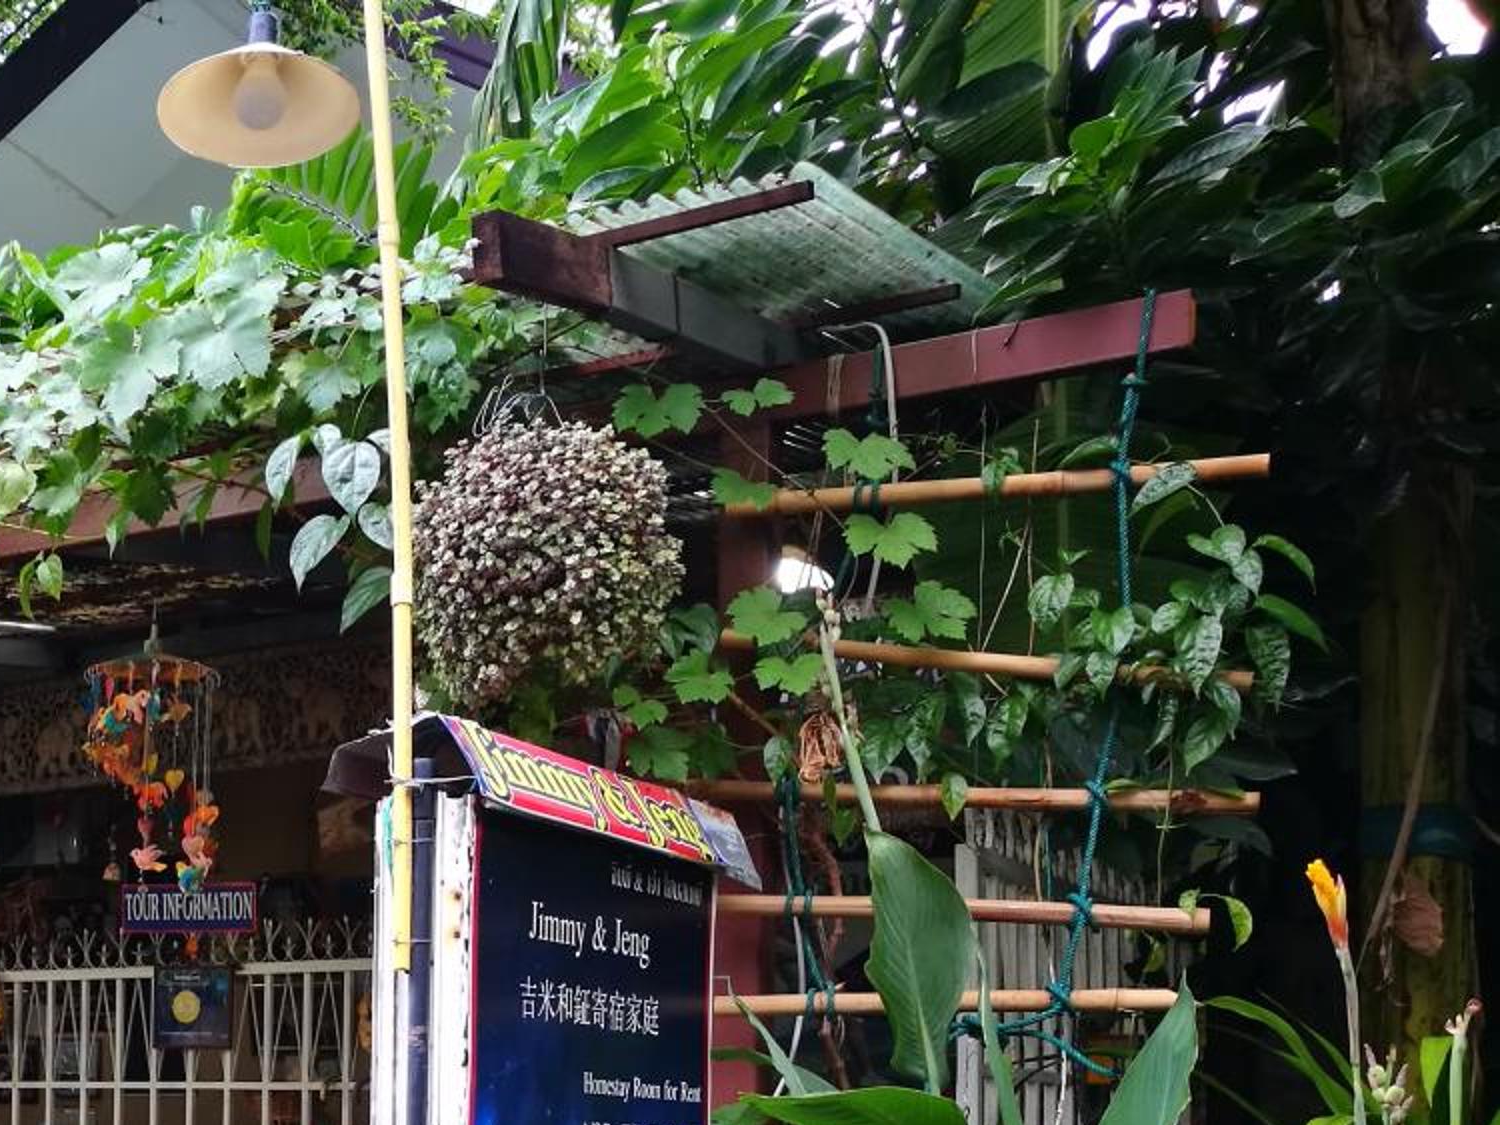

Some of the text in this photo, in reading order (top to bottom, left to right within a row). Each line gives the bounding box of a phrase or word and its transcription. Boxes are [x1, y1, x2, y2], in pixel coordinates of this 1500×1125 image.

[460, 719, 606, 832] Jimmy
[125, 891, 254, 922] TOUR INFORMATION
[529, 900, 650, 969] Jimmy & Jeng
[583, 1071, 701, 1103] Homestay Room for Rent
